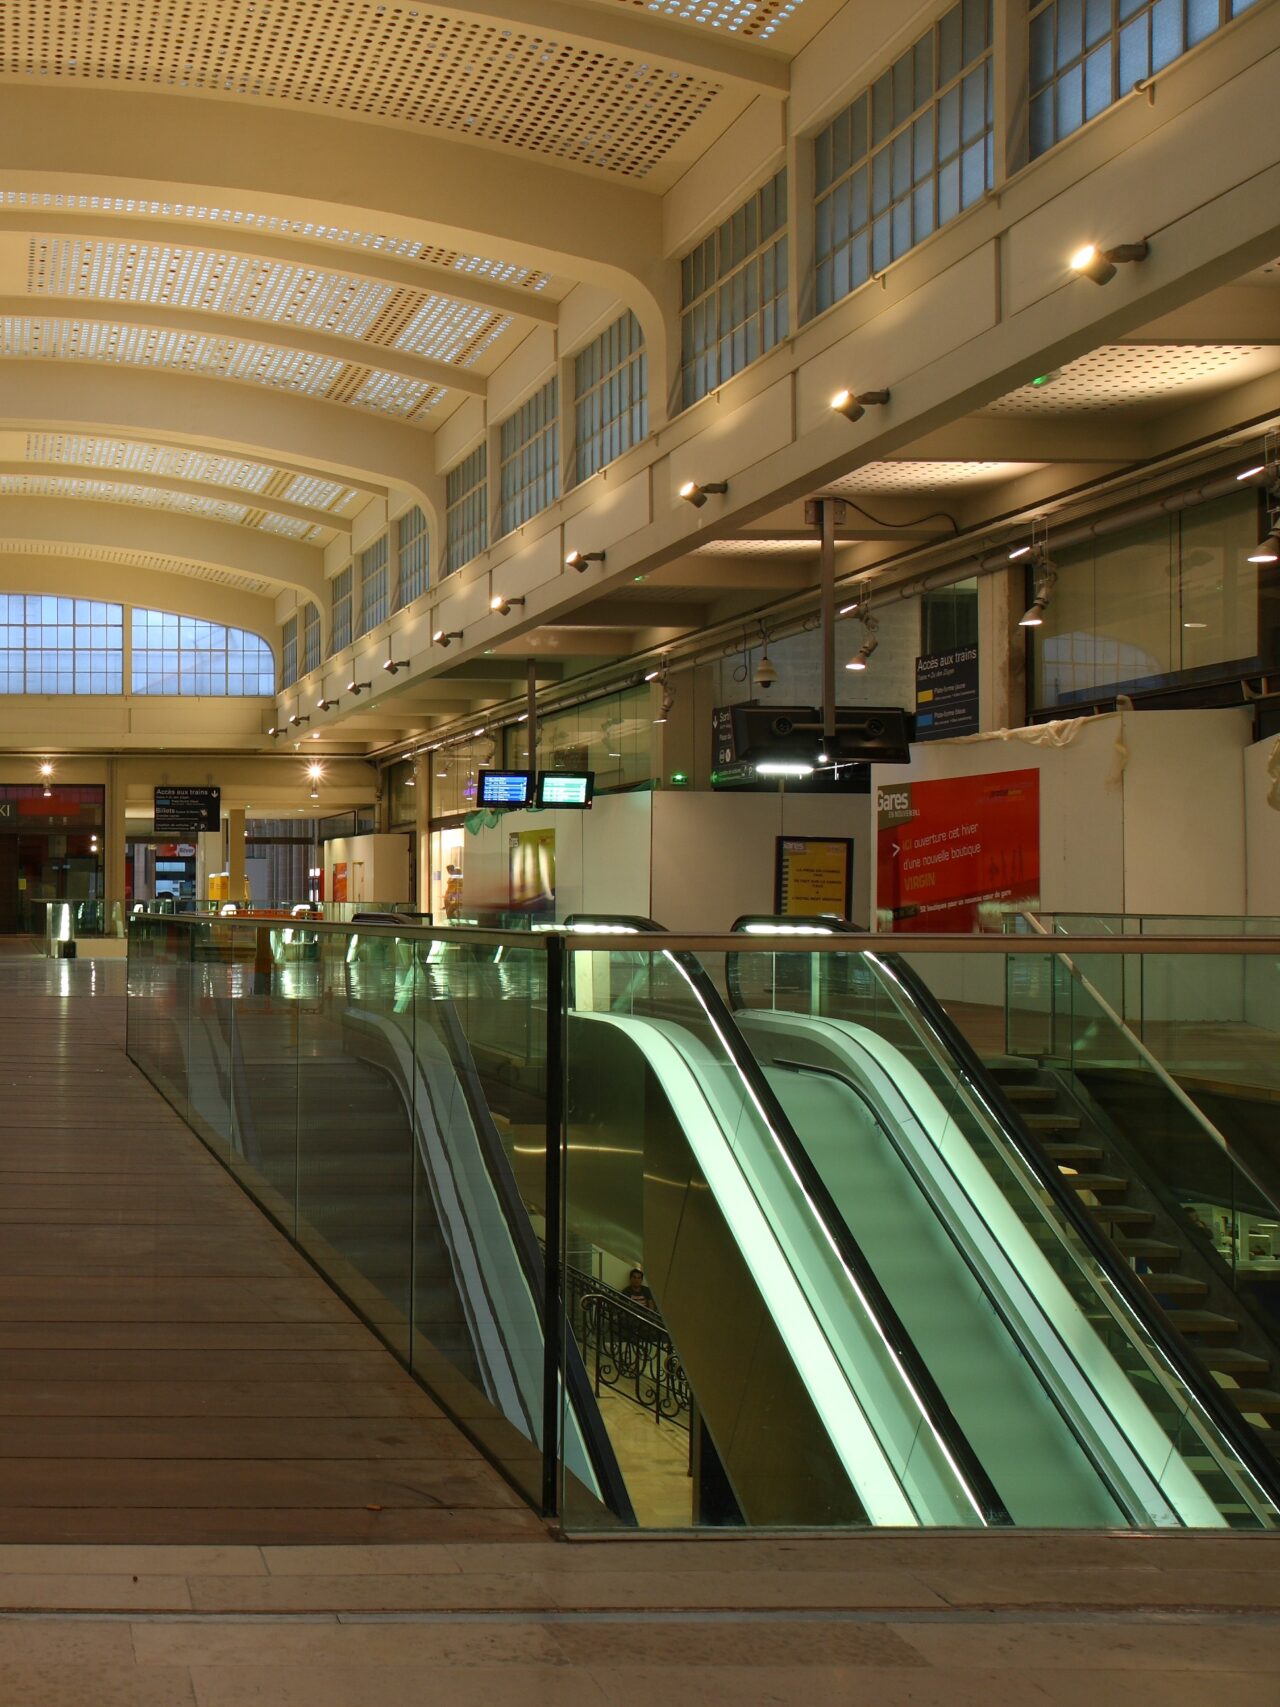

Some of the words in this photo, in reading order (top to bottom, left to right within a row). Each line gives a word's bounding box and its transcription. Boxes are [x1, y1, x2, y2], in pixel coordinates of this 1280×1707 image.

[917, 656, 939, 671] Accès
[939, 655, 954, 667] aux
[955, 647, 977, 663] trains
[914, 831, 947, 849] ouverture
[948, 829, 960, 840] cet
[961, 822, 979, 836] hiver
[903, 857, 921, 871] d'une
[922, 849, 950, 868] nouvelle
[951, 842, 982, 861] boutique
[904, 871, 936, 891] VIRGIN
